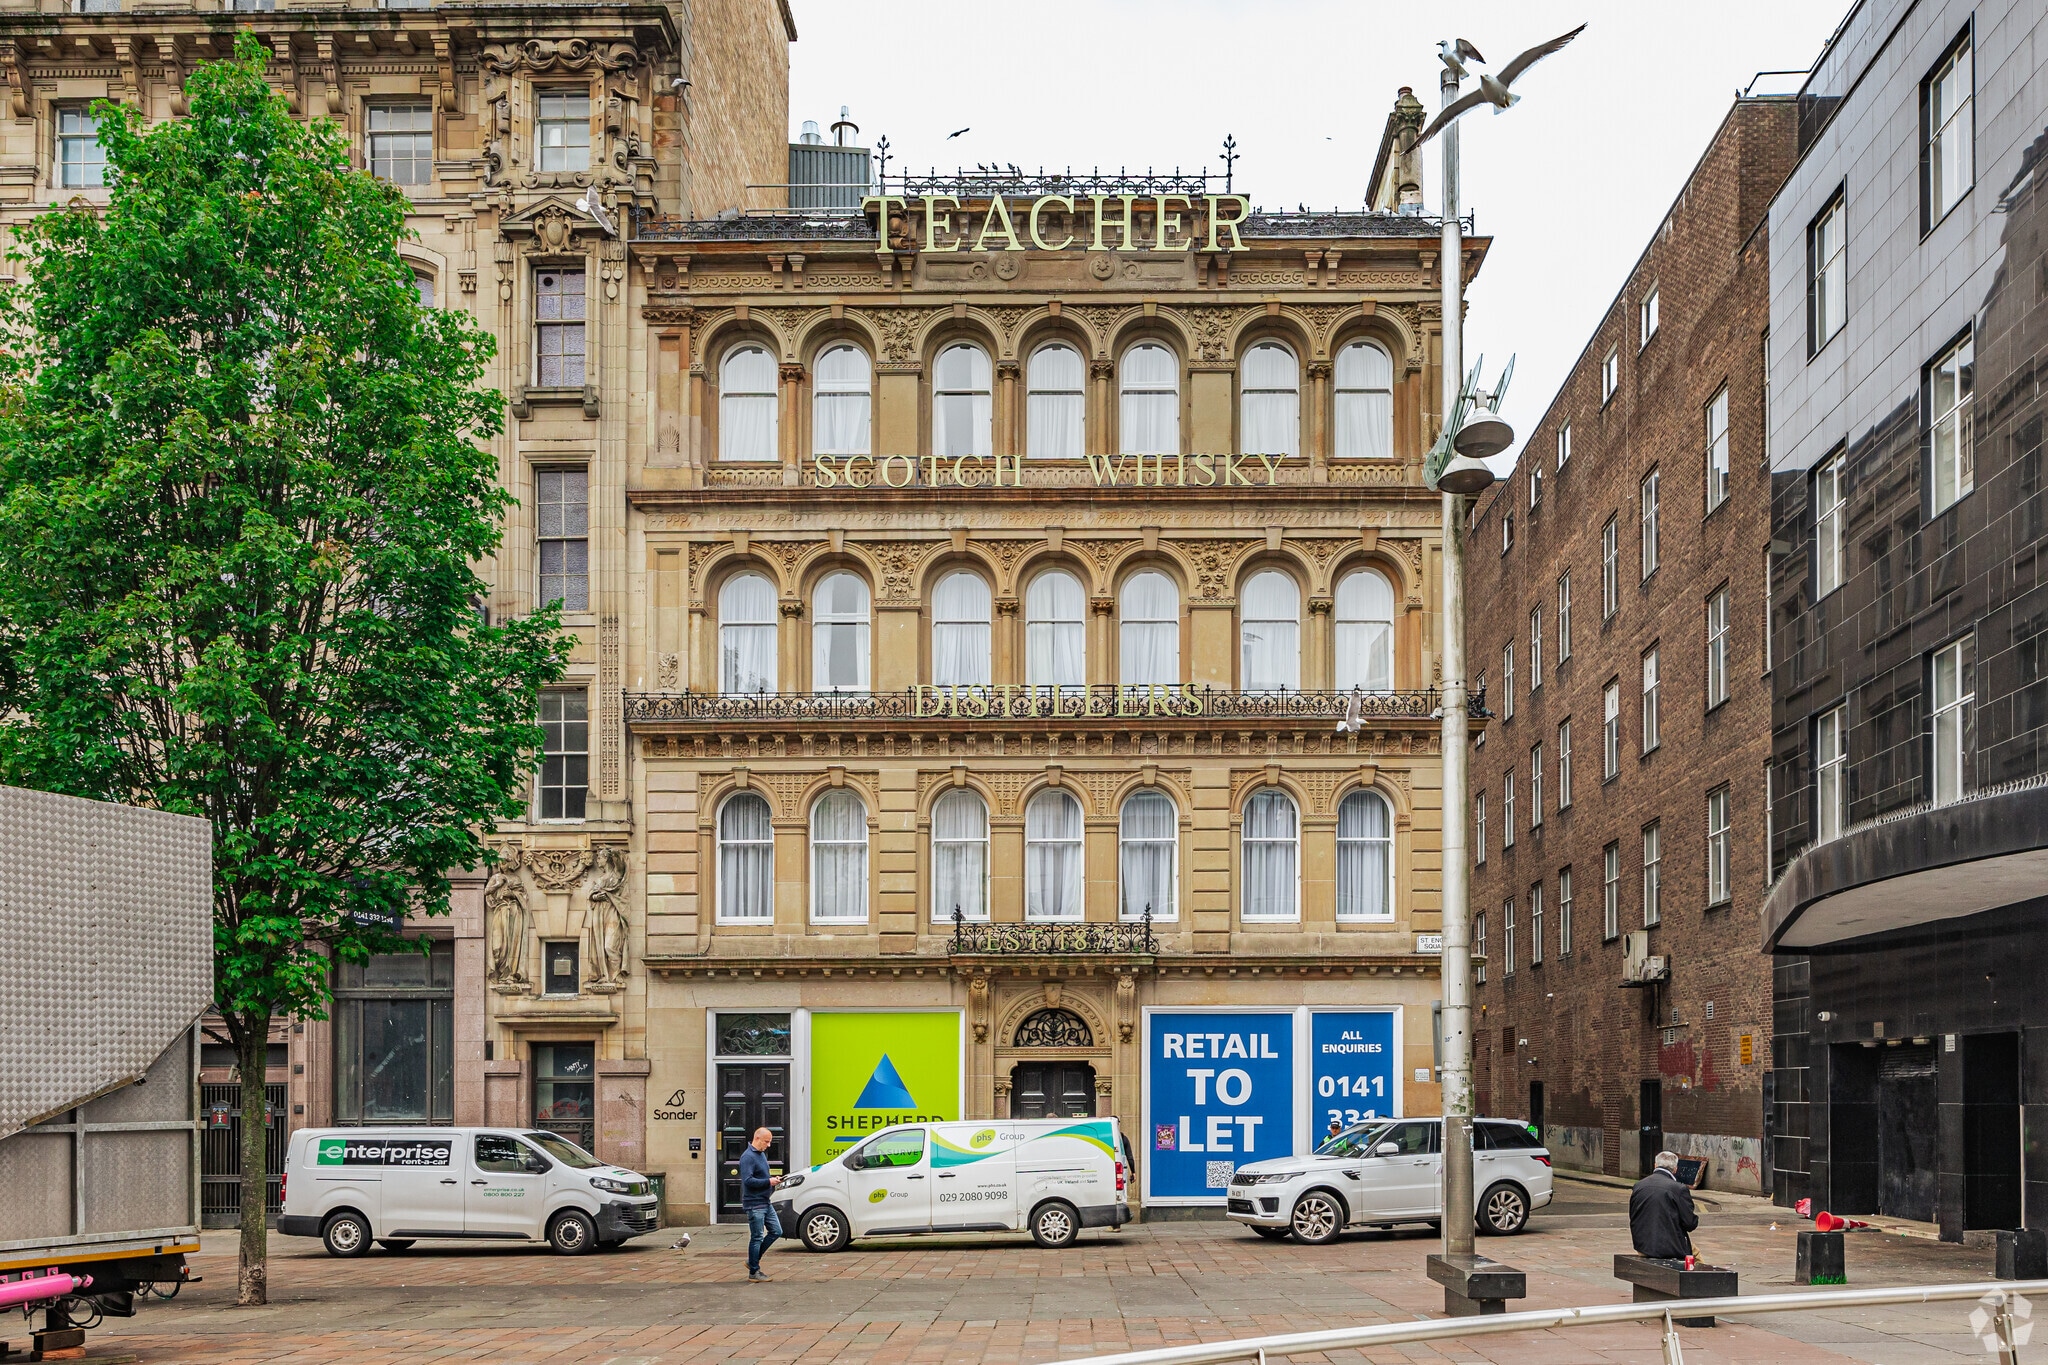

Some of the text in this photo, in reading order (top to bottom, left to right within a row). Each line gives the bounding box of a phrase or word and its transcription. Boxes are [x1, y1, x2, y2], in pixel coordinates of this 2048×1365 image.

[860, 193, 1251, 253] TEACHER
[814, 452, 1288, 488] SCOTCH WHISKY
[911, 682, 1204, 718] DISTILLERS
[985, 928, 1121, 951] EST. 1871
[1163, 1033, 1279, 1059] RETAIL
[1341, 1030, 1363, 1040] ALL
[1321, 1043, 1383, 1054] ENQUIRIES
[1186, 1068, 1253, 1106] TO
[1318, 1075, 1384, 1098] 0141
[653, 1109, 698, 1120] Sonder
[976, 1131, 1025, 1143] phs Group
[1179, 1115, 1264, 1153] LET
[325, 1144, 450, 1163] enterprise
[873, 1191, 909, 1200] phs Group
[939, 1191, 1008, 1203] 029 2080 9098
